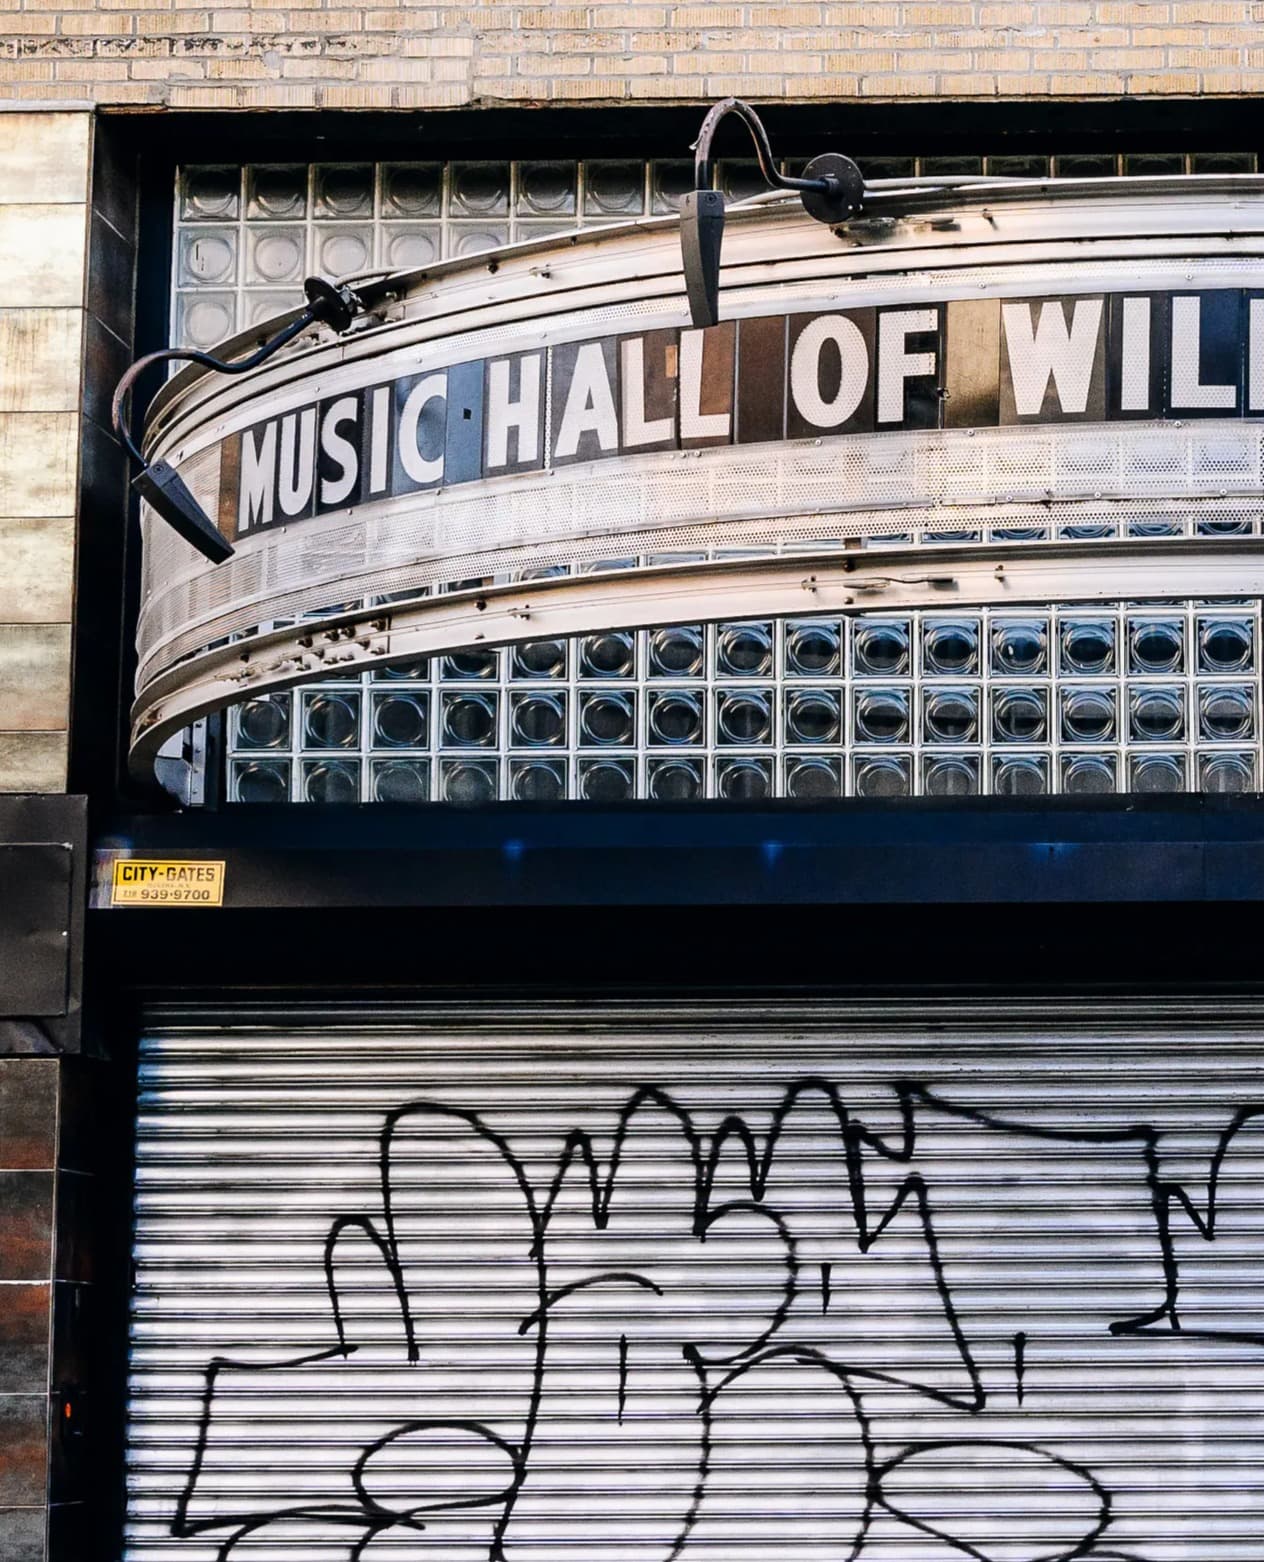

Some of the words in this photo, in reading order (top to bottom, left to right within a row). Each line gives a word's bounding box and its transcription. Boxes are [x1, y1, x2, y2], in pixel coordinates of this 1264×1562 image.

[237, 373, 448, 533] MUSIC
[486, 328, 731, 469] HALL
[790, 308, 939, 428] OF
[122, 866, 216, 882] CITY-GATES
